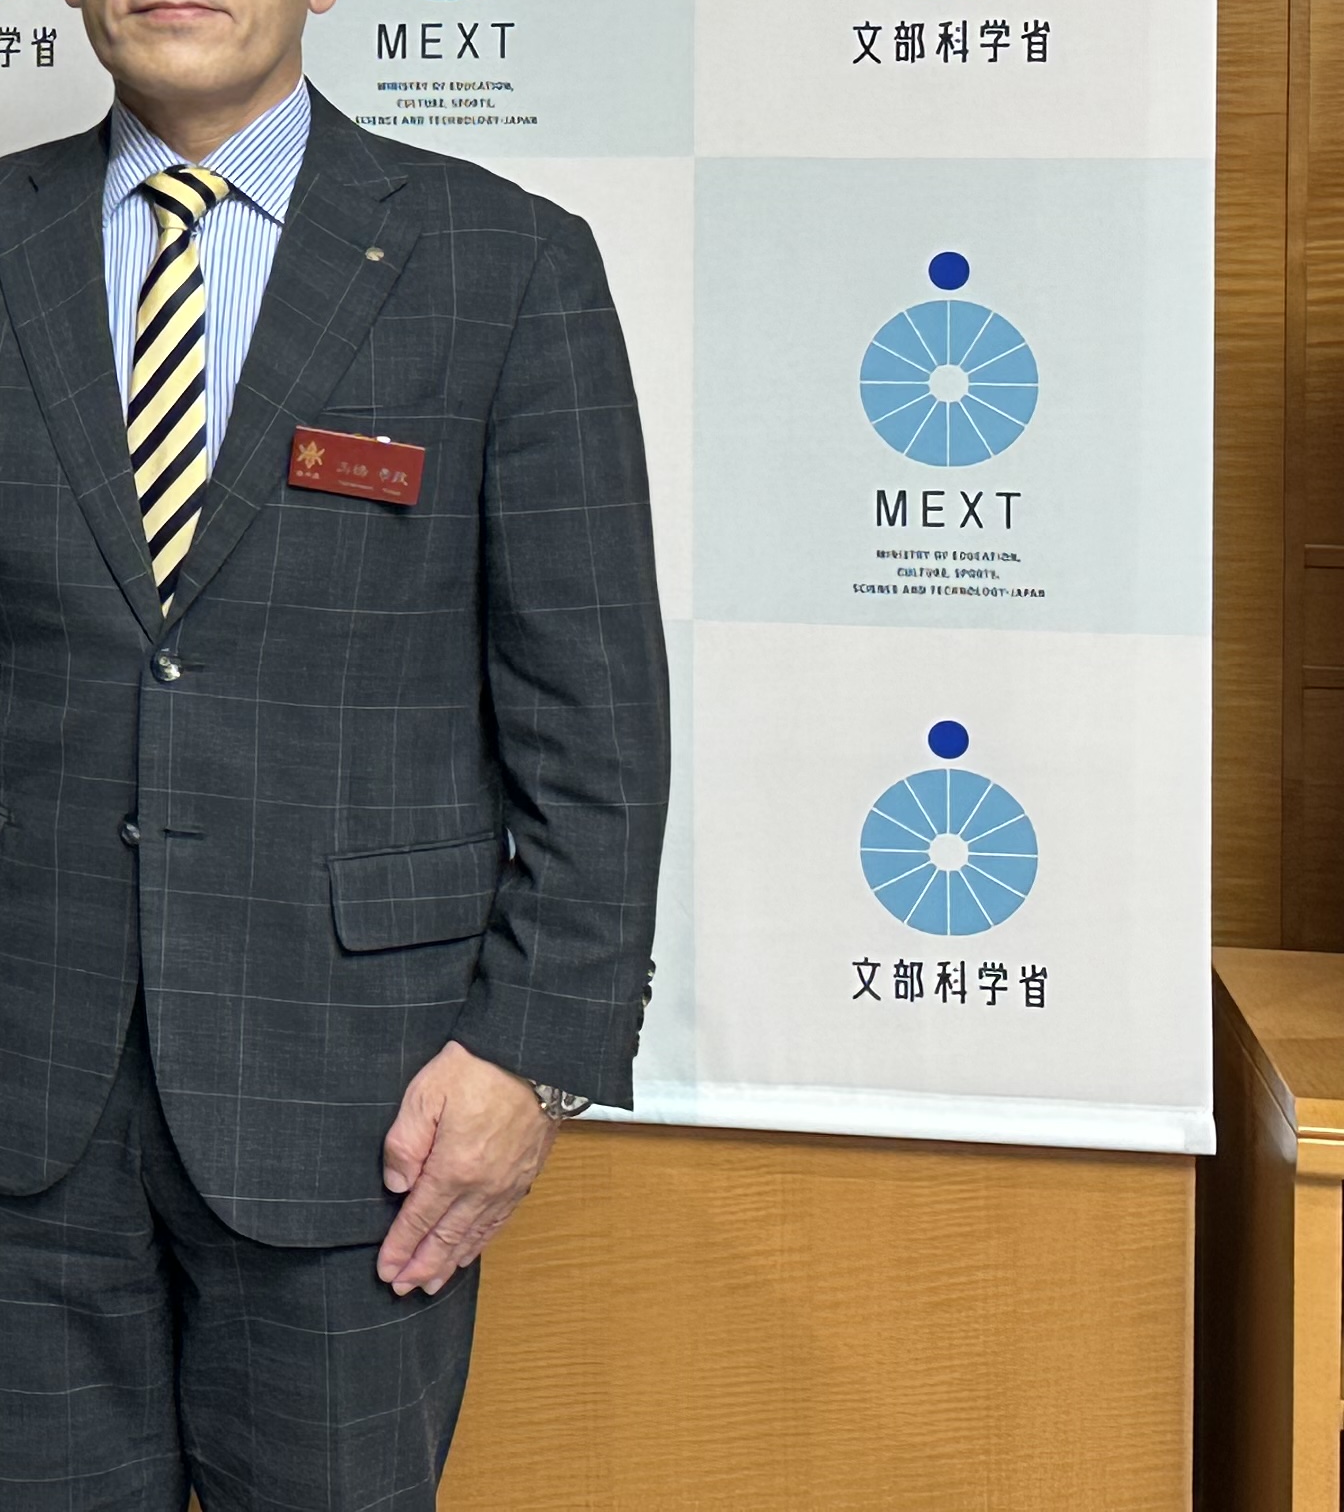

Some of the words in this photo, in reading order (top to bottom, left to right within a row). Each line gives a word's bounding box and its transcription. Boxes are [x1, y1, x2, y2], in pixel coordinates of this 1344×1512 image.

[377, 23, 515, 59] MEXT
[853, 20, 1050, 64] 文部科学省
[877, 490, 1021, 529] MEXT
[852, 957, 1047, 1008] 文部科学省
